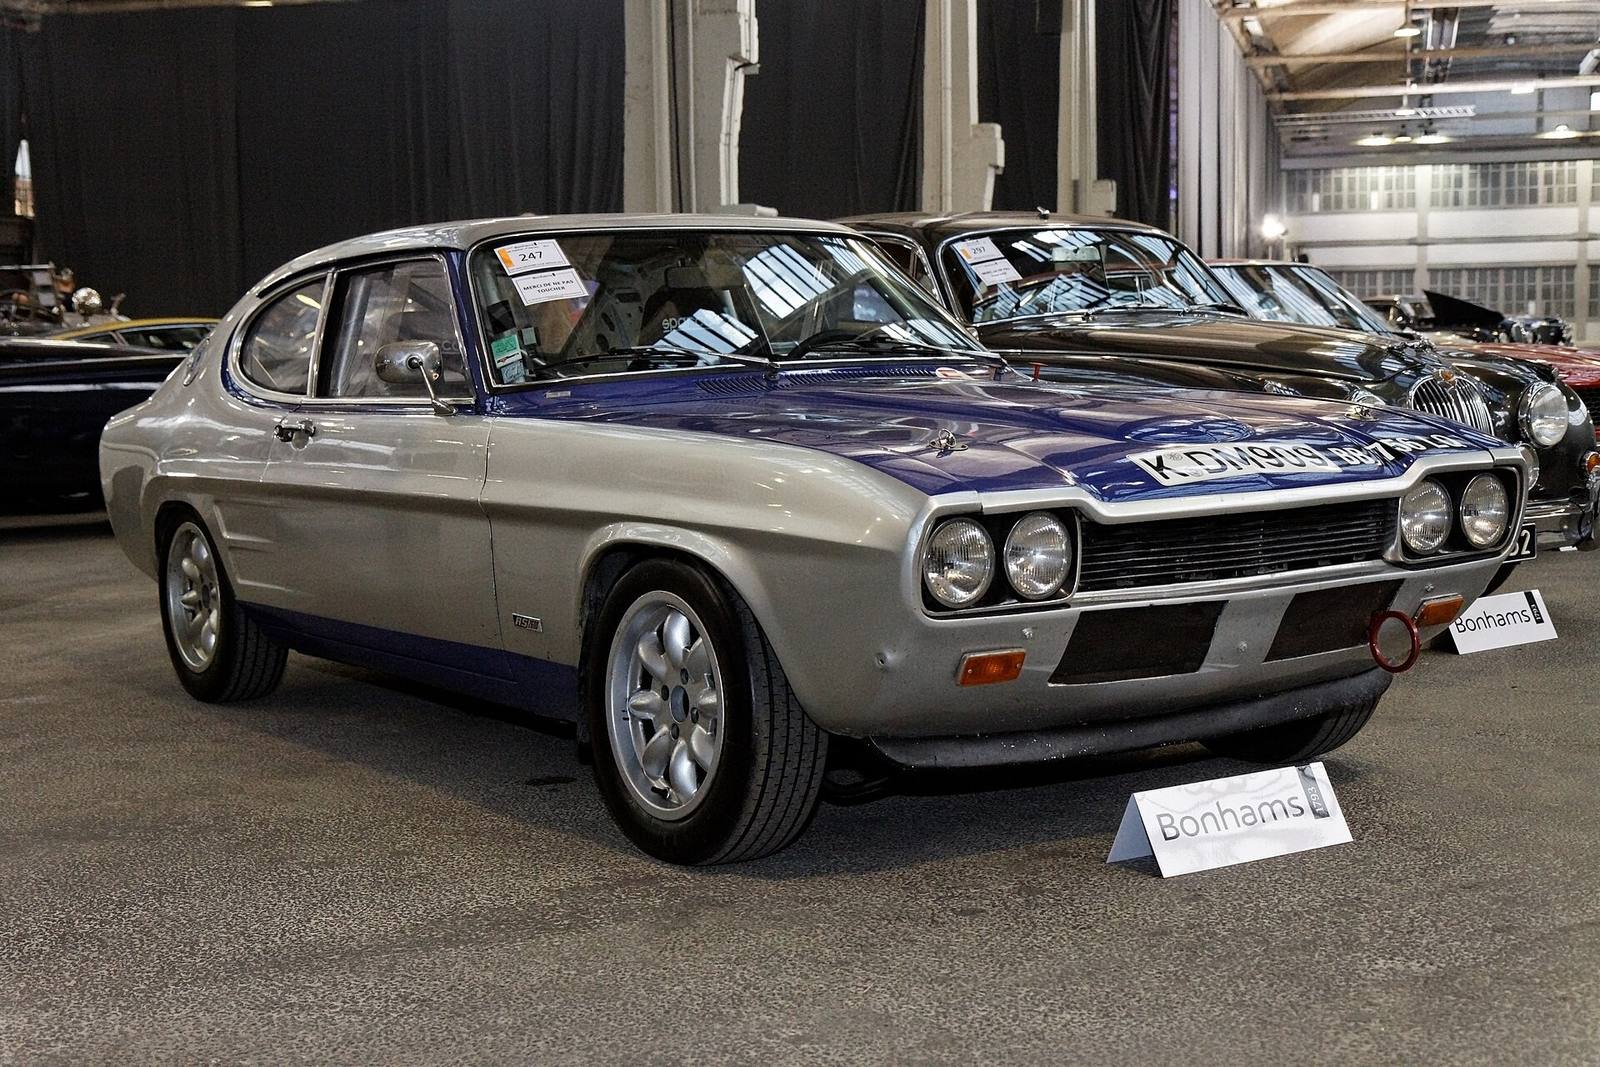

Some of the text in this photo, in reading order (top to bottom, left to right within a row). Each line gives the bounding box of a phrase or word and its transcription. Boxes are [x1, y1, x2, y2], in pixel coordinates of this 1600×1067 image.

[518, 251, 543, 262] 247
[537, 286, 566, 294] TOUCHER
[1141, 455, 1188, 480] K
[1455, 609, 1531, 634] Bonhams
[1155, 786, 1325, 842] Bonhams 1793
